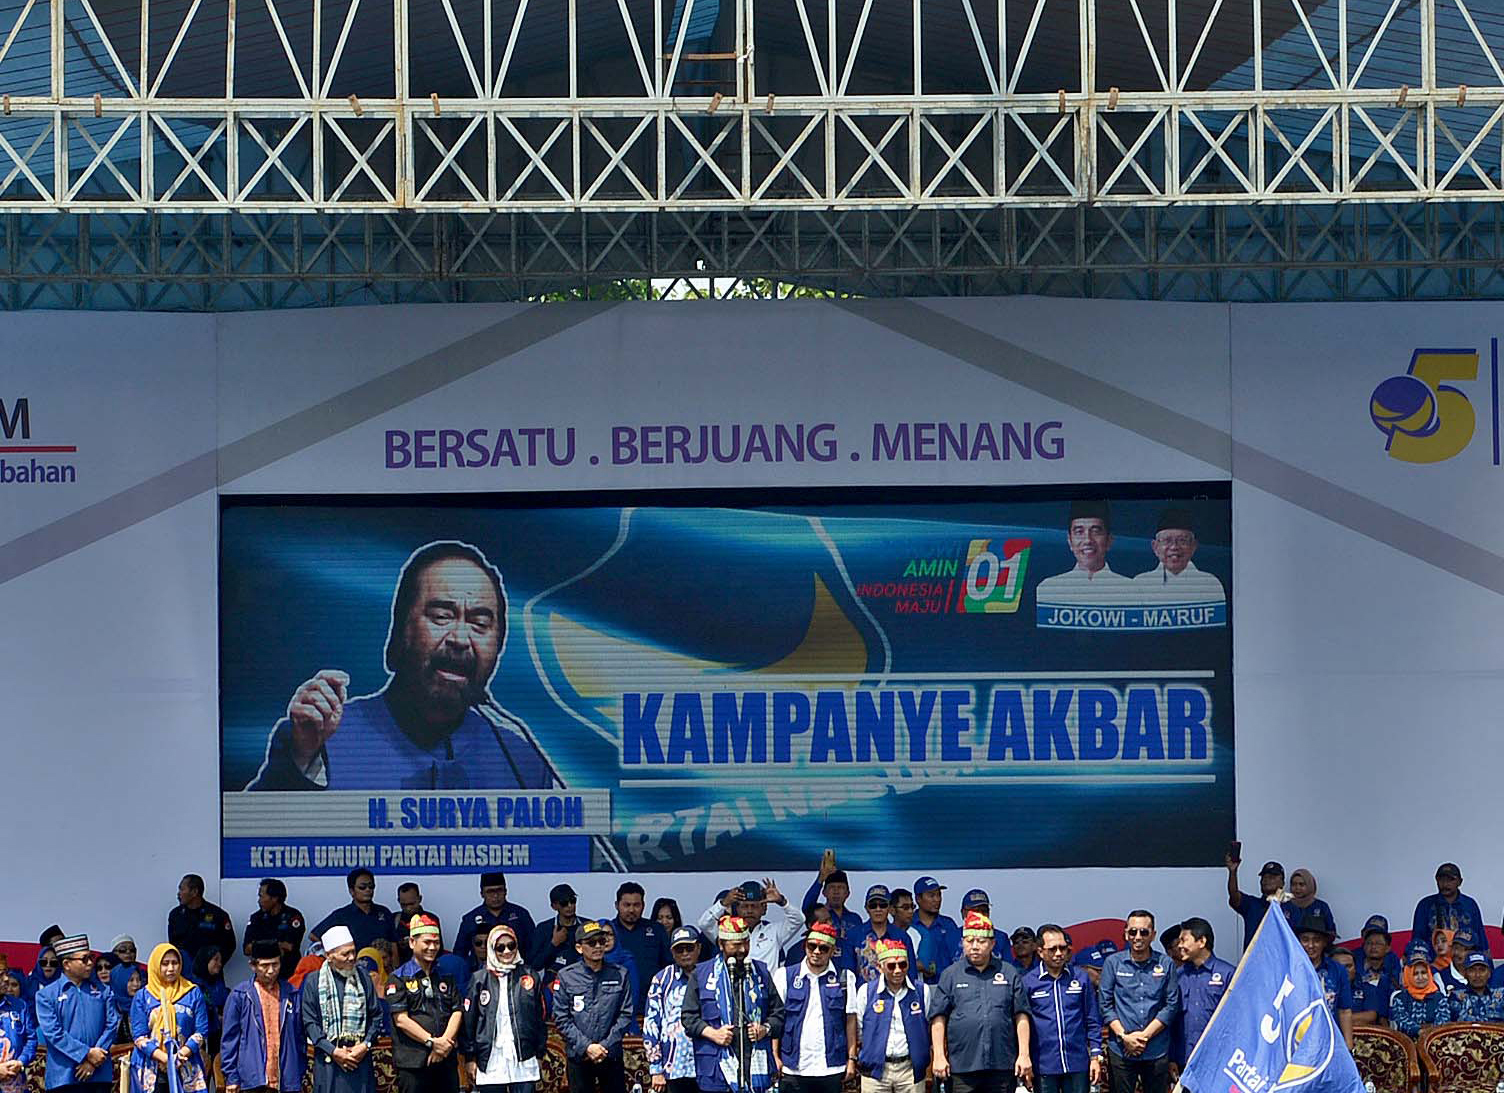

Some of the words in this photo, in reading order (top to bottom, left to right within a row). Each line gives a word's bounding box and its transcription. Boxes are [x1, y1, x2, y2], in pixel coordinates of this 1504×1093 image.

[385, 428, 578, 469] BERSATU
[611, 424, 838, 466] BERJUANG
[872, 421, 1065, 461] MENANG
[903, 560, 957, 578] AMIN
[967, 551, 1023, 600] 01
[856, 584, 944, 597] INDONESIA
[895, 600, 940, 613] MAJU
[1048, 608, 1126, 627] JOKOWI
[621, 686, 972, 766] KAMPANYE
[989, 685, 1210, 762] AKBAR
[368, 798, 394, 828] H.
[399, 796, 492, 828] SURYA
[497, 796, 584, 828] PALOH
[250, 846, 310, 869] KETUA
[314, 845, 375, 869] UMUM
[378, 844, 445, 868] PARTAI
[448, 843, 530, 868] NASDEM
